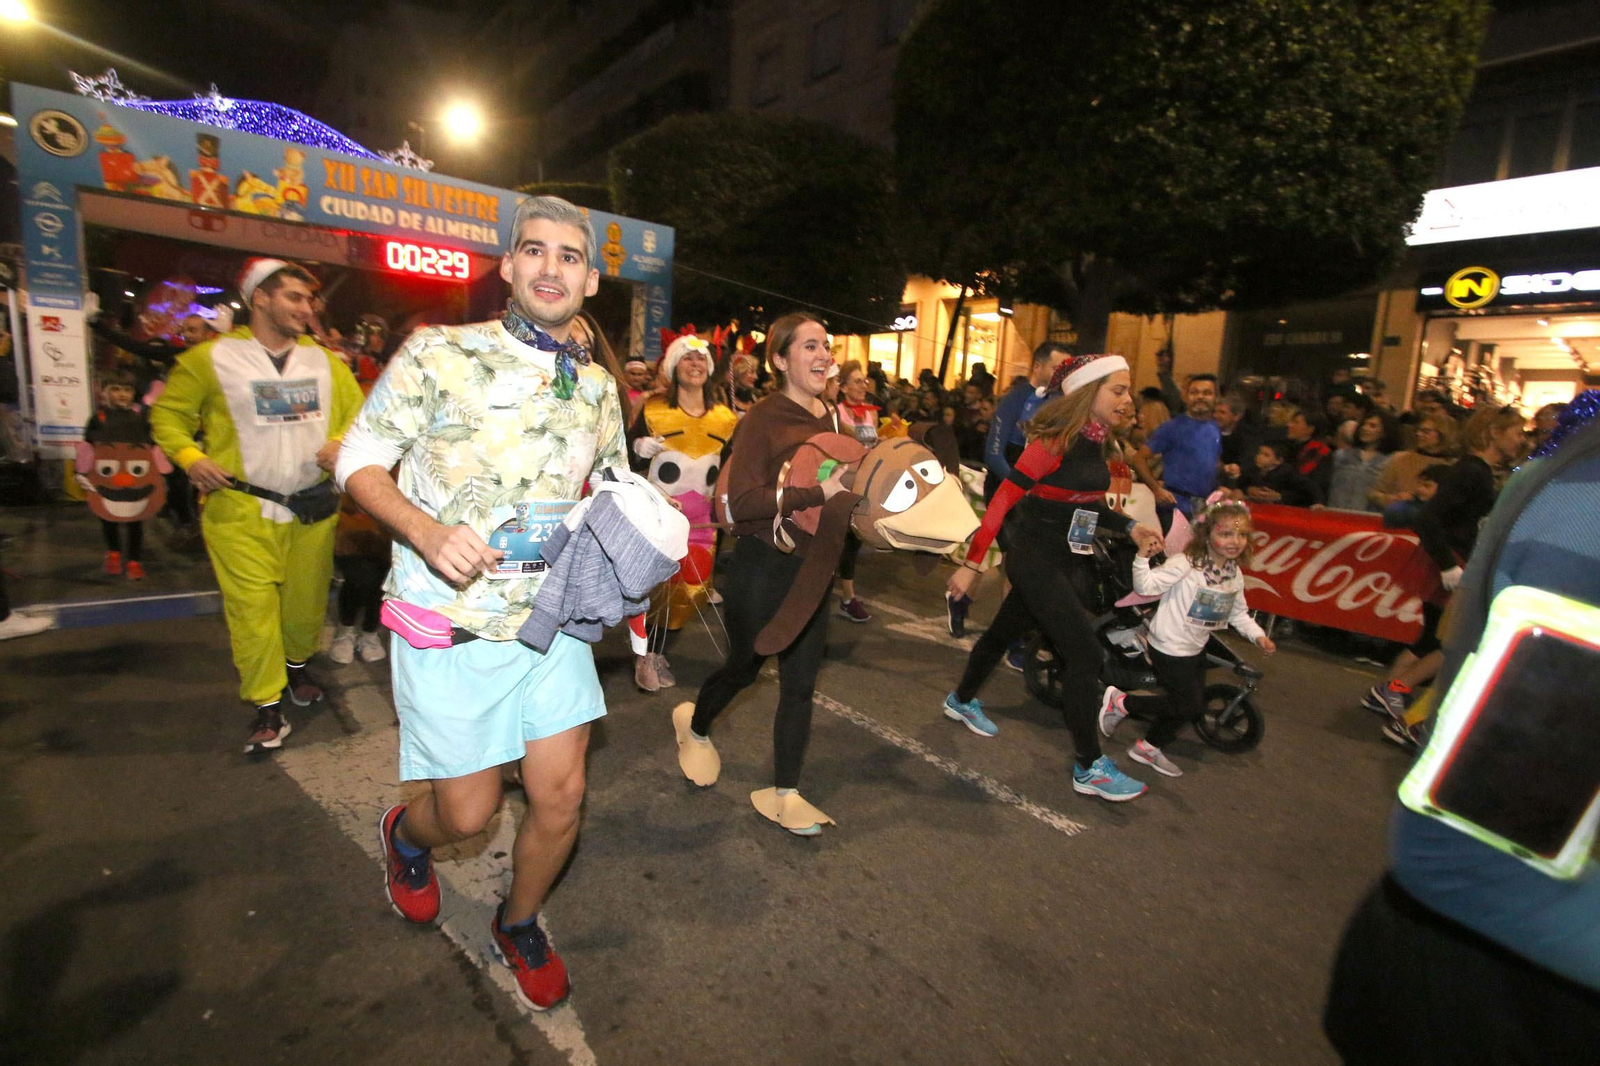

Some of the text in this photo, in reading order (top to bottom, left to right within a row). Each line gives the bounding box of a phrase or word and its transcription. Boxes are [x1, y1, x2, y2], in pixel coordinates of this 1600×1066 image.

[322, 158, 499, 223] XII SAN SILVESTRE
[319, 195, 500, 246] CIUDAD DE ALMERÍA
